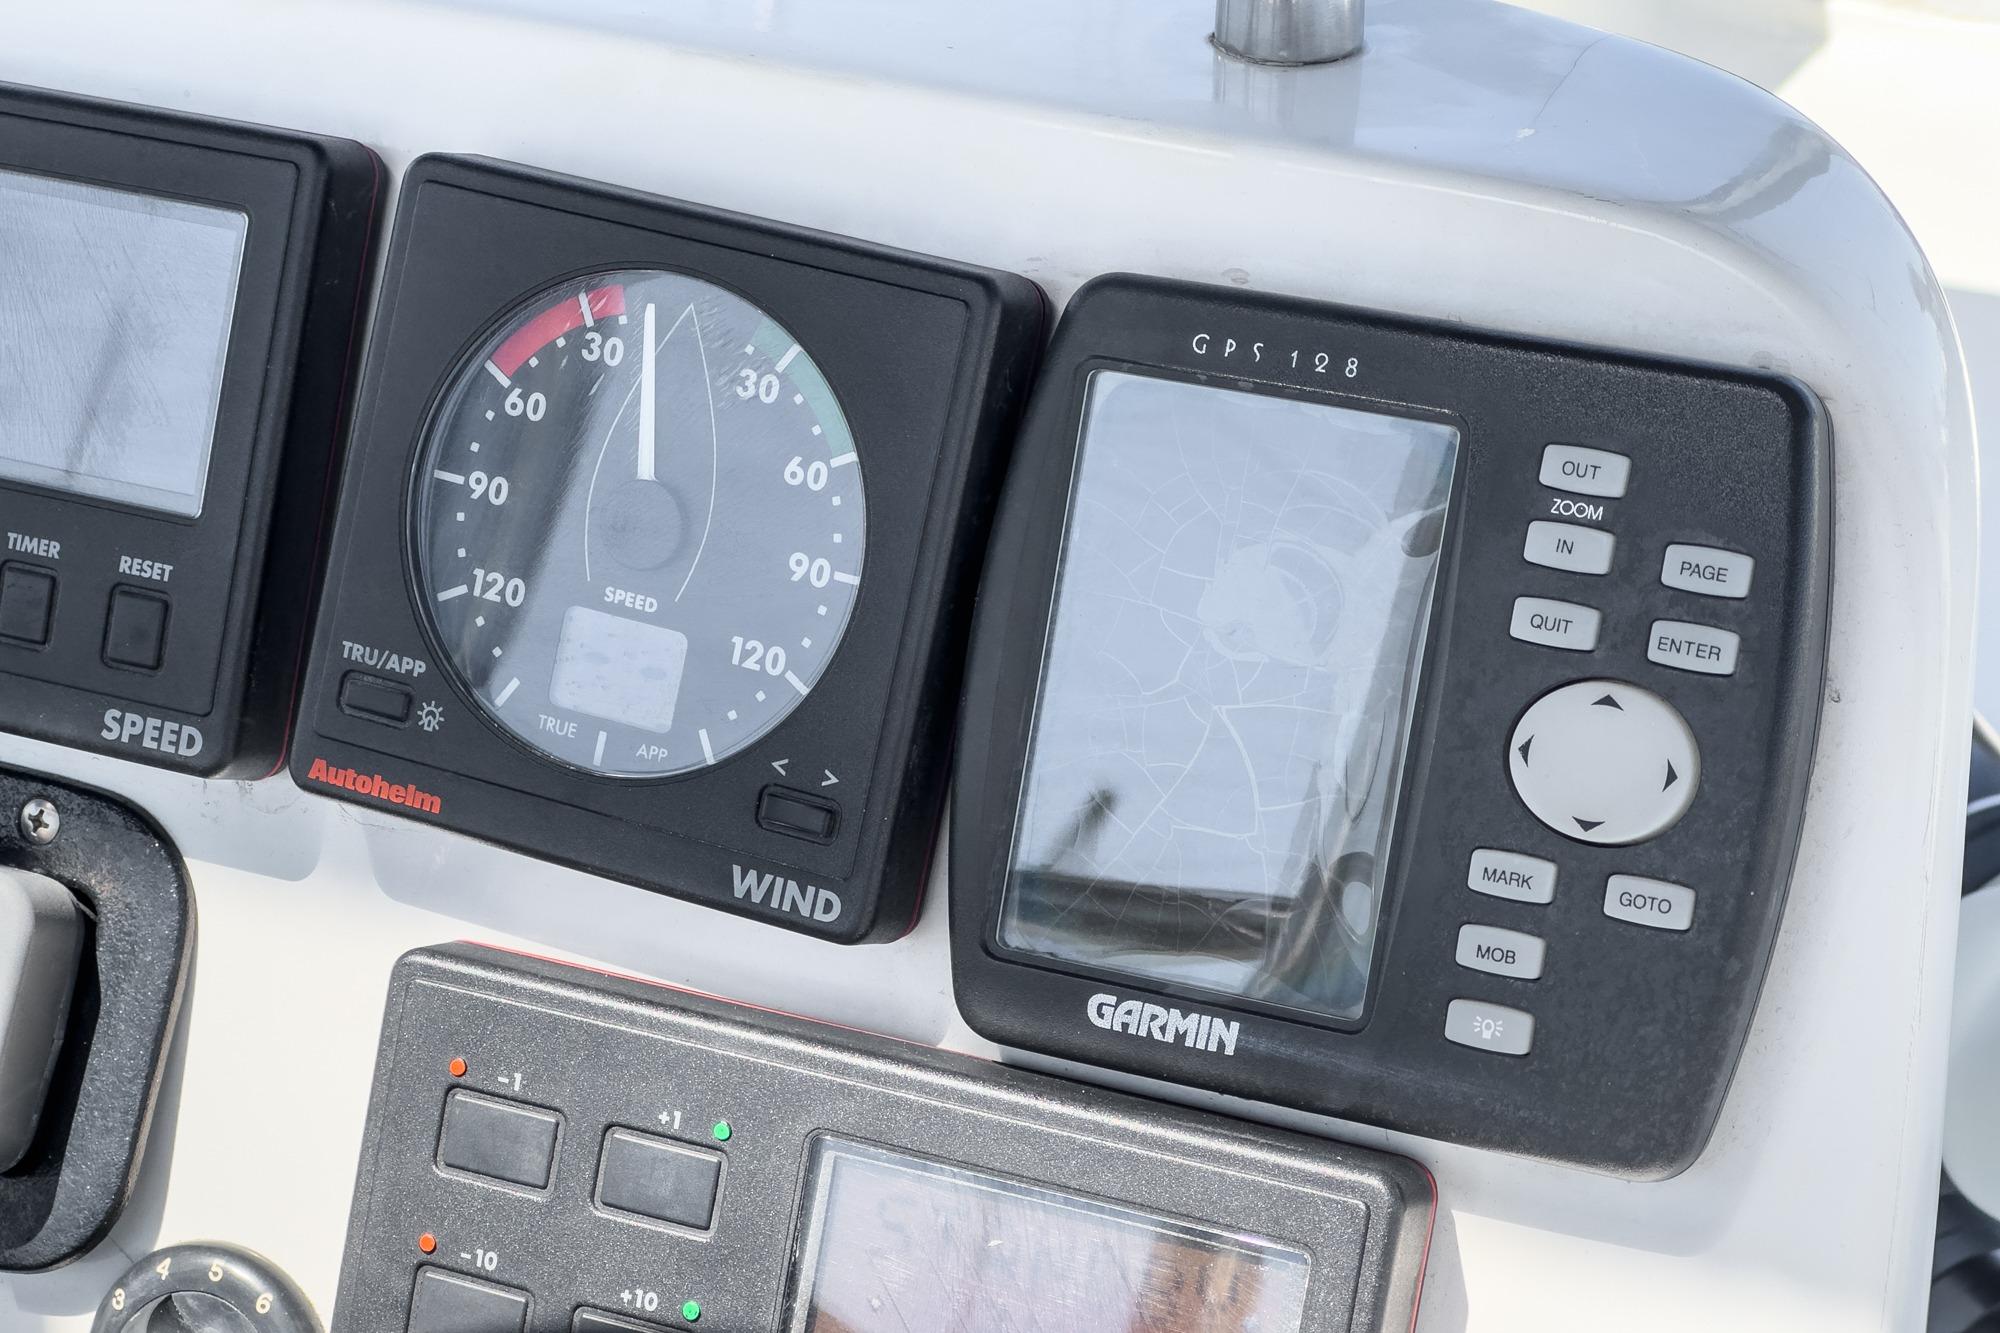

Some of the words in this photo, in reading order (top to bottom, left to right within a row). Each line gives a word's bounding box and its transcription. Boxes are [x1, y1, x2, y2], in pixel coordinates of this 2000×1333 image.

[581, 331, 624, 367] 30
[1192, 333, 1263, 362] GPS
[1291, 350, 1358, 378] 128
[735, 368, 780, 404] 30
[504, 388, 547, 422] 60
[783, 456, 829, 491] 60
[1561, 461, 1602, 480] OUT
[467, 470, 509, 506] 90
[1550, 498, 1604, 521] ZOOM
[7, 531, 61, 560] TIMER
[1555, 538, 1575, 555] IN
[118, 554, 174, 583] RESET
[788, 552, 832, 588] 90
[1680, 561, 1729, 583] PAGE
[471, 567, 526, 608] 120
[603, 585, 658, 613] SPEED
[1530, 613, 1573, 635] QUIT
[341, 640, 426, 679] TRU/APP
[731, 636, 787, 677] 120
[1657, 636, 1722, 661] ENTER
[100, 707, 204, 758] SPEED
[538, 713, 578, 739] TRUE
[635, 743, 668, 763] APP
[307, 758, 442, 815] Autohelm
[1482, 866, 1534, 890] MARK
[732, 864, 842, 923] WIND
[1619, 891, 1672, 914] GOTO
[1476, 944, 1517, 965] MOB
[1086, 993, 1241, 1056] GARMIN
[497, 1073, 522, 1092] -1
[658, 1111, 682, 1130] +1
[156, 1257, 171, 1280] 4
[208, 1262, 223, 1282] 5
[460, 1249, 498, 1271] -10
[112, 1288, 126, 1310] 3
[255, 1292, 273, 1315] 6
[620, 1288, 659, 1312] +10
